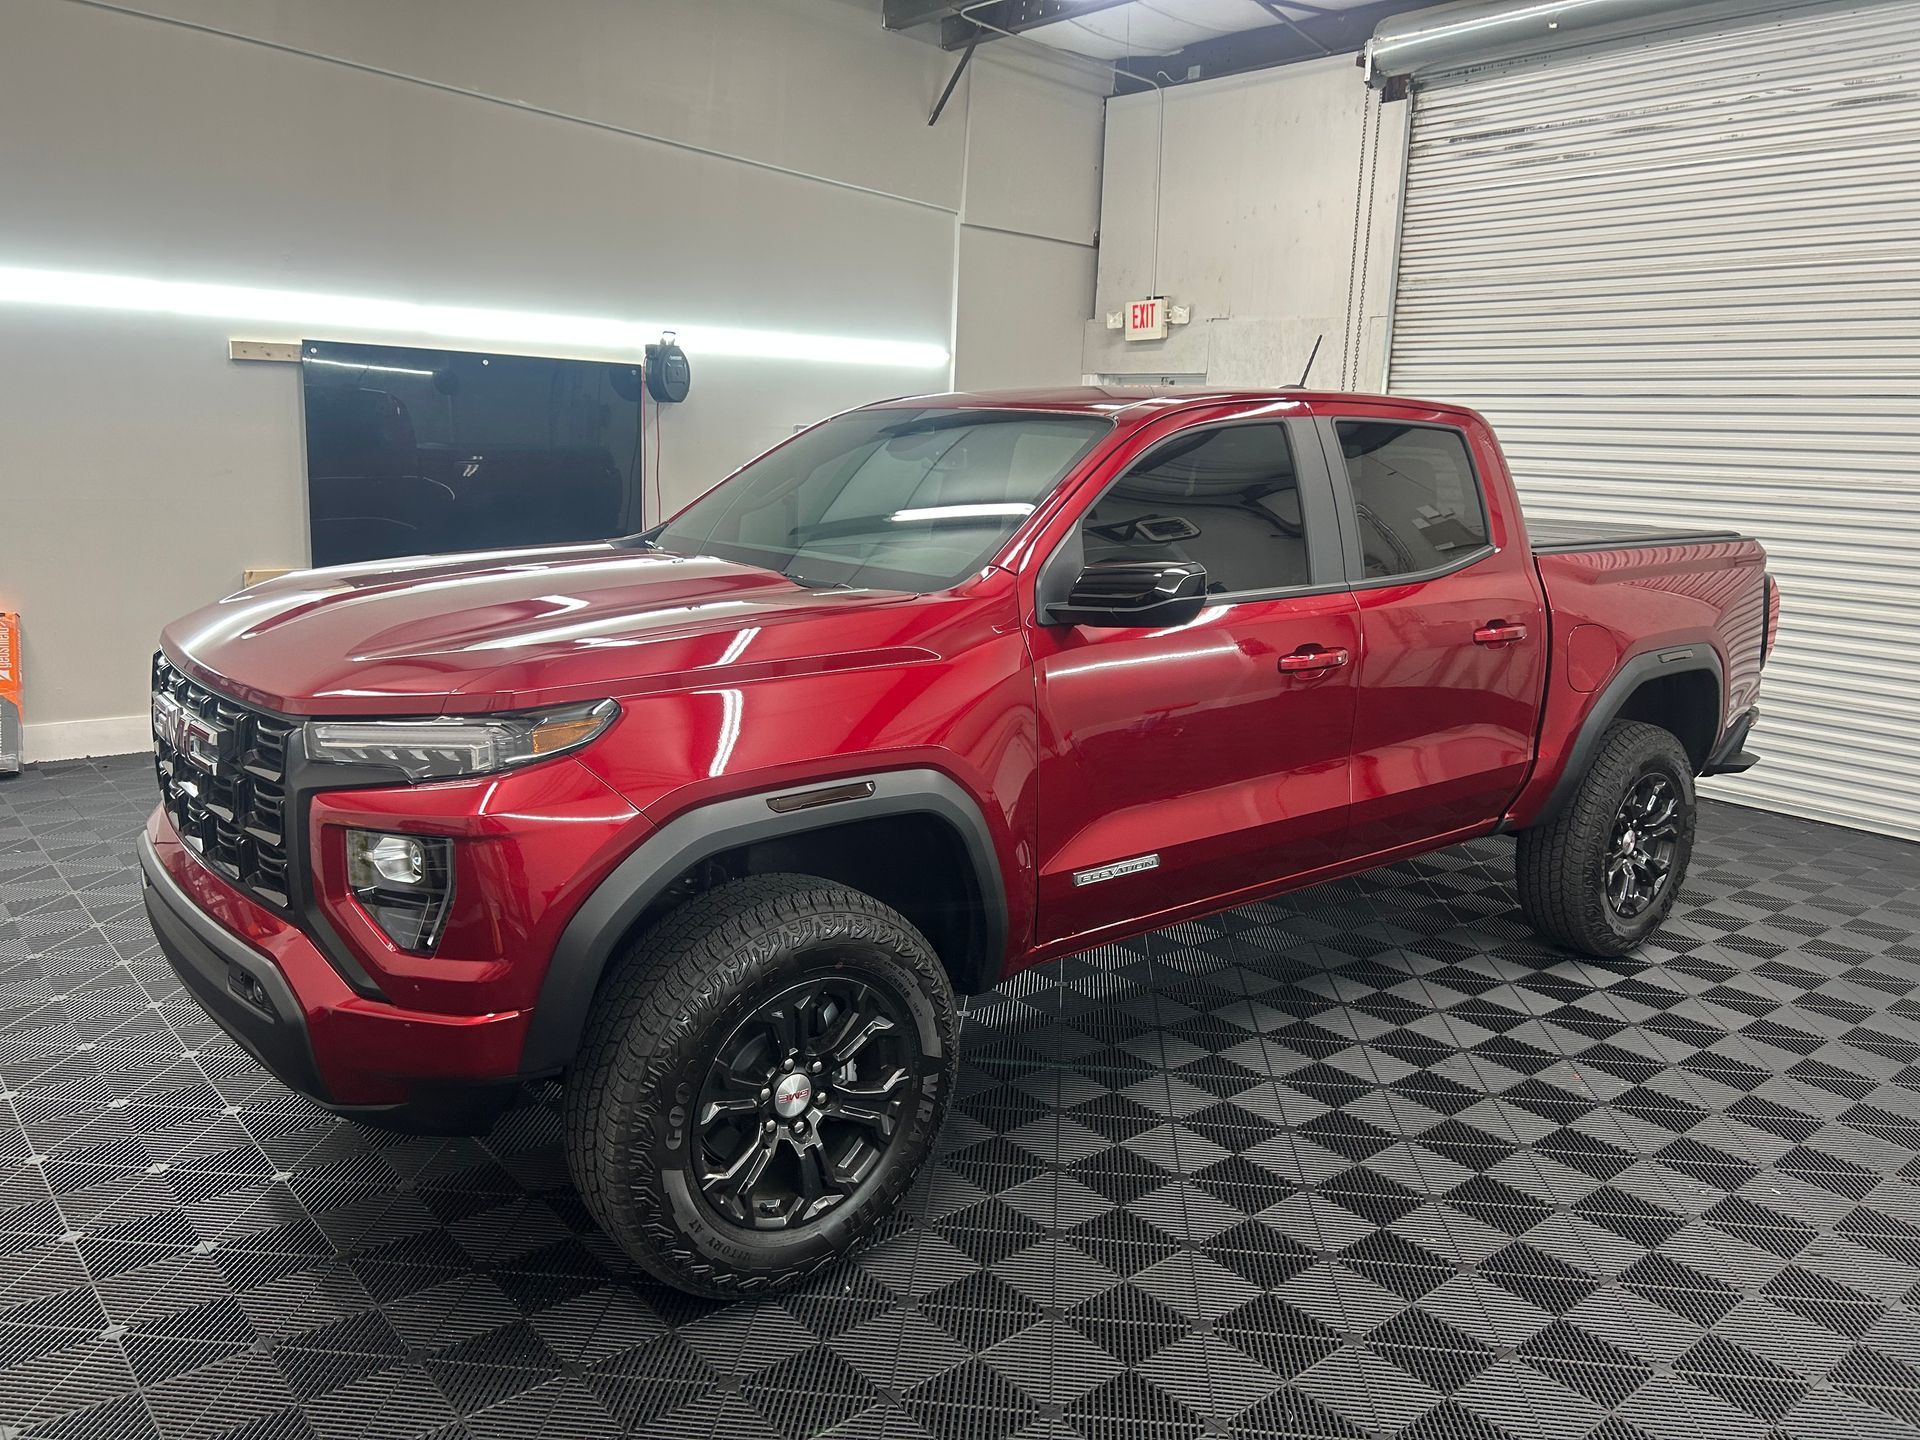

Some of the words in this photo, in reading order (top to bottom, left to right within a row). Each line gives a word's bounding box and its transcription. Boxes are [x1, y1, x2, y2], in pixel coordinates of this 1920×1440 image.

[1132, 303, 1155, 329] EXIT
[152, 691, 219, 776] GMC
[1080, 859, 1155, 883] ELEVATION
[778, 1087, 809, 1104] GMC
